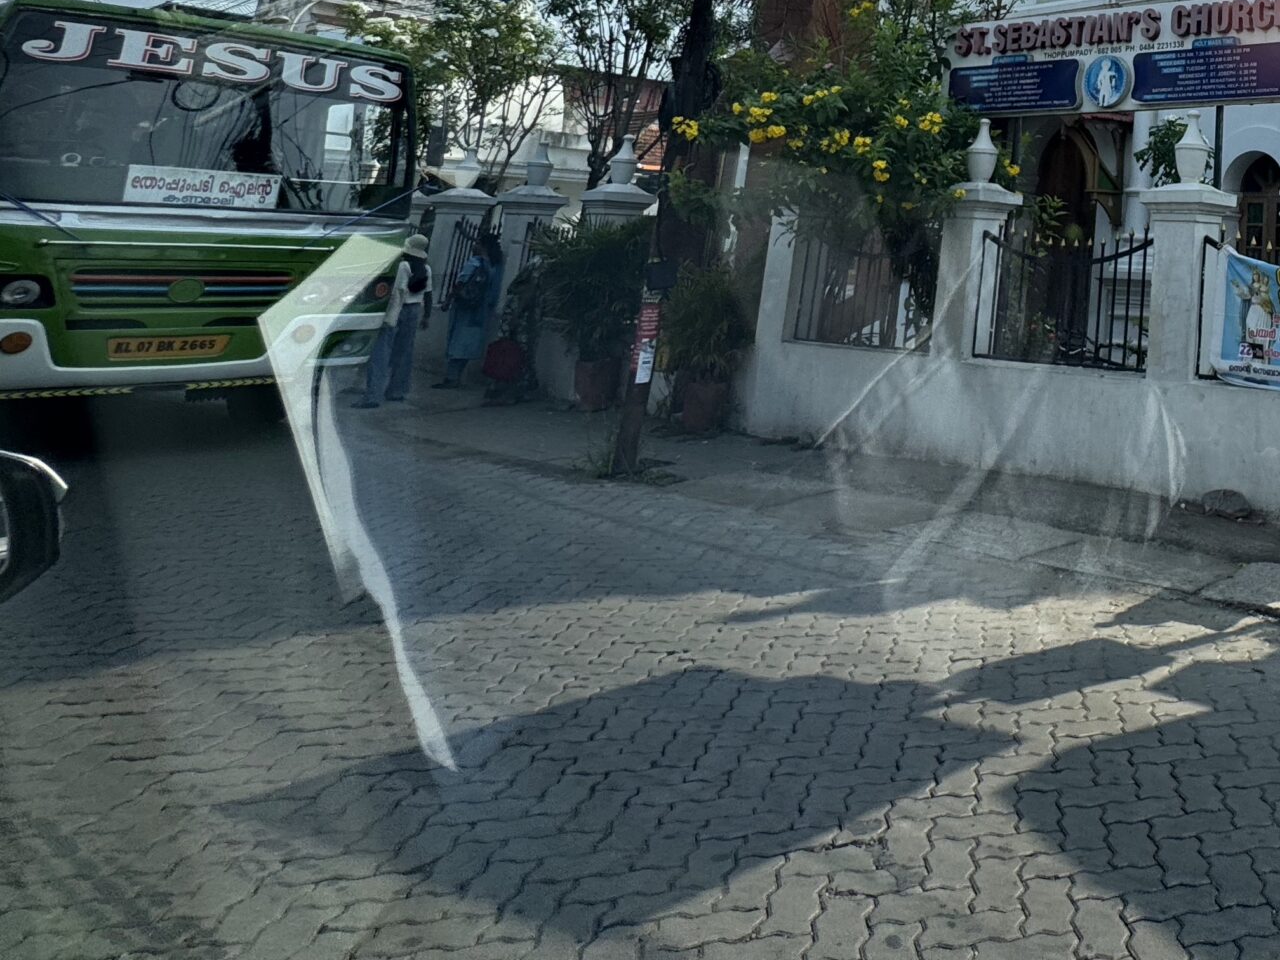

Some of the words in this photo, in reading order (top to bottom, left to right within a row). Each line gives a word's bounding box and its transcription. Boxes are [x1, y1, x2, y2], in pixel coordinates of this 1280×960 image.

[955, 27, 992, 56] ST.
[992, 9, 1161, 54] SEBASTIAN'S
[22, 21, 403, 103] JESUS
[1044, 49, 1092, 59] THOPPUMPADY
[137, 341, 152, 352] 07
[178, 340, 216, 351] 2665
